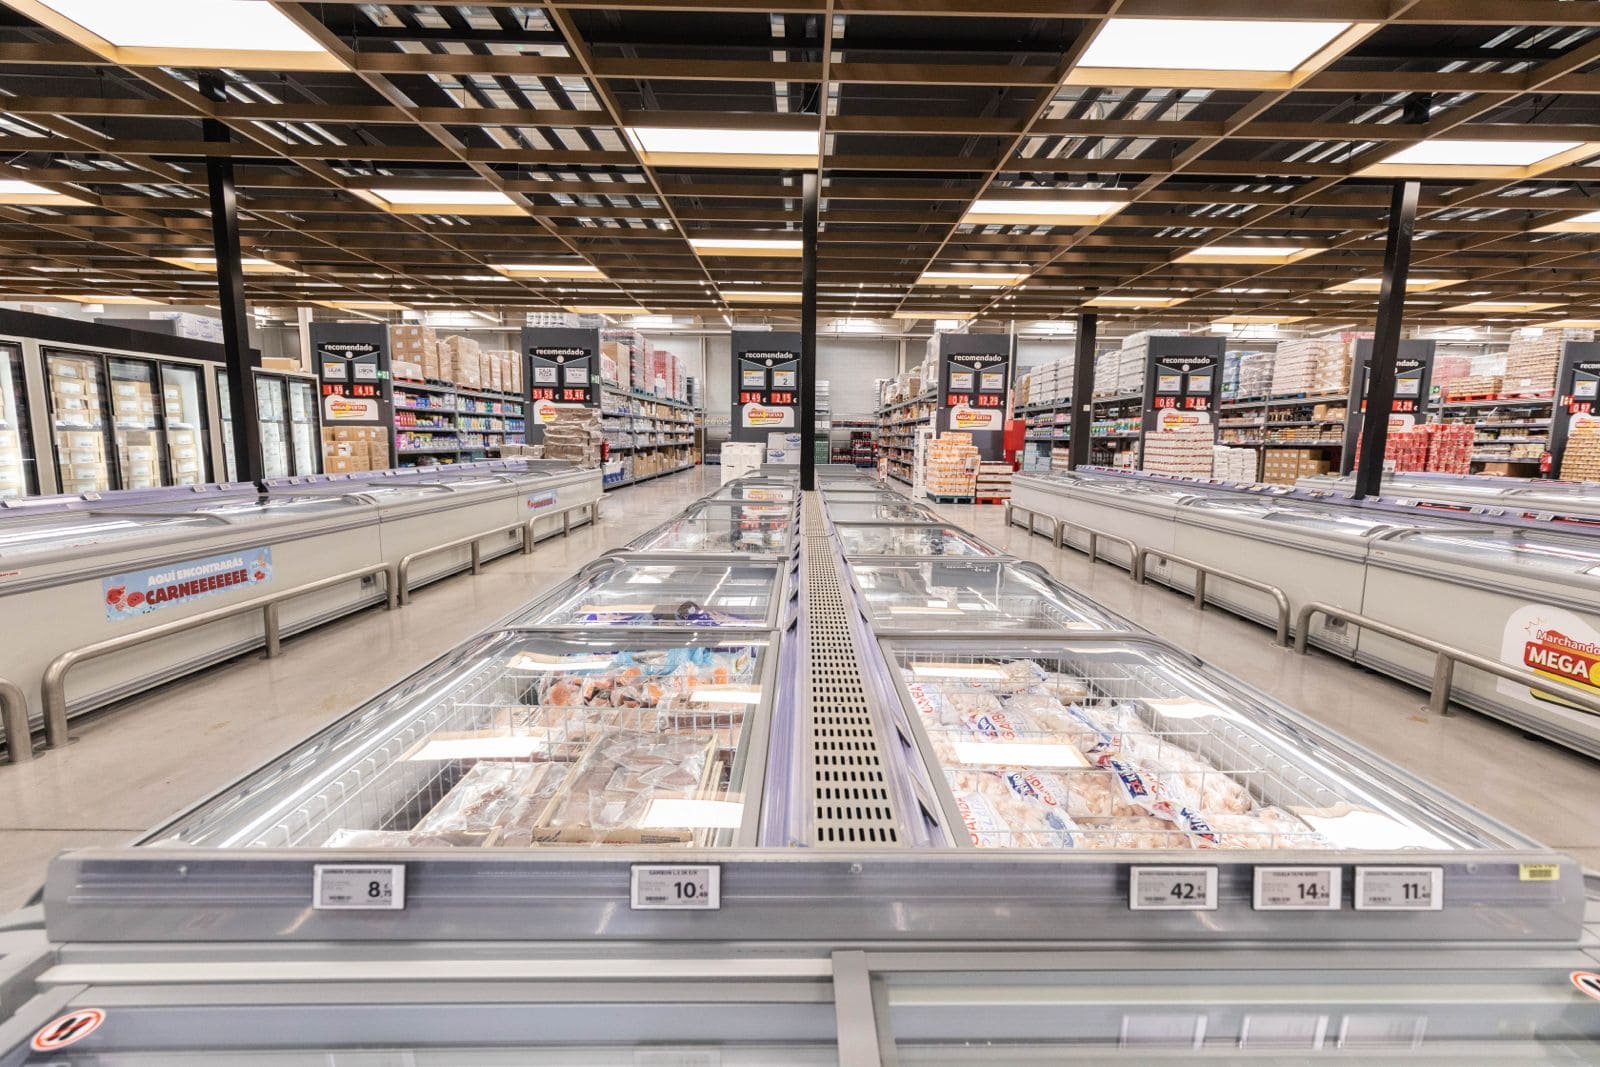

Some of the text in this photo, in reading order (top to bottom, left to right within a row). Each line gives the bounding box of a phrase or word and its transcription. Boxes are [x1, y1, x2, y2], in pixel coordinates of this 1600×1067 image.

[148, 558, 243, 586] AQUÍ ENCONTRARÁS
[1529, 646, 1589, 678] MEGA
